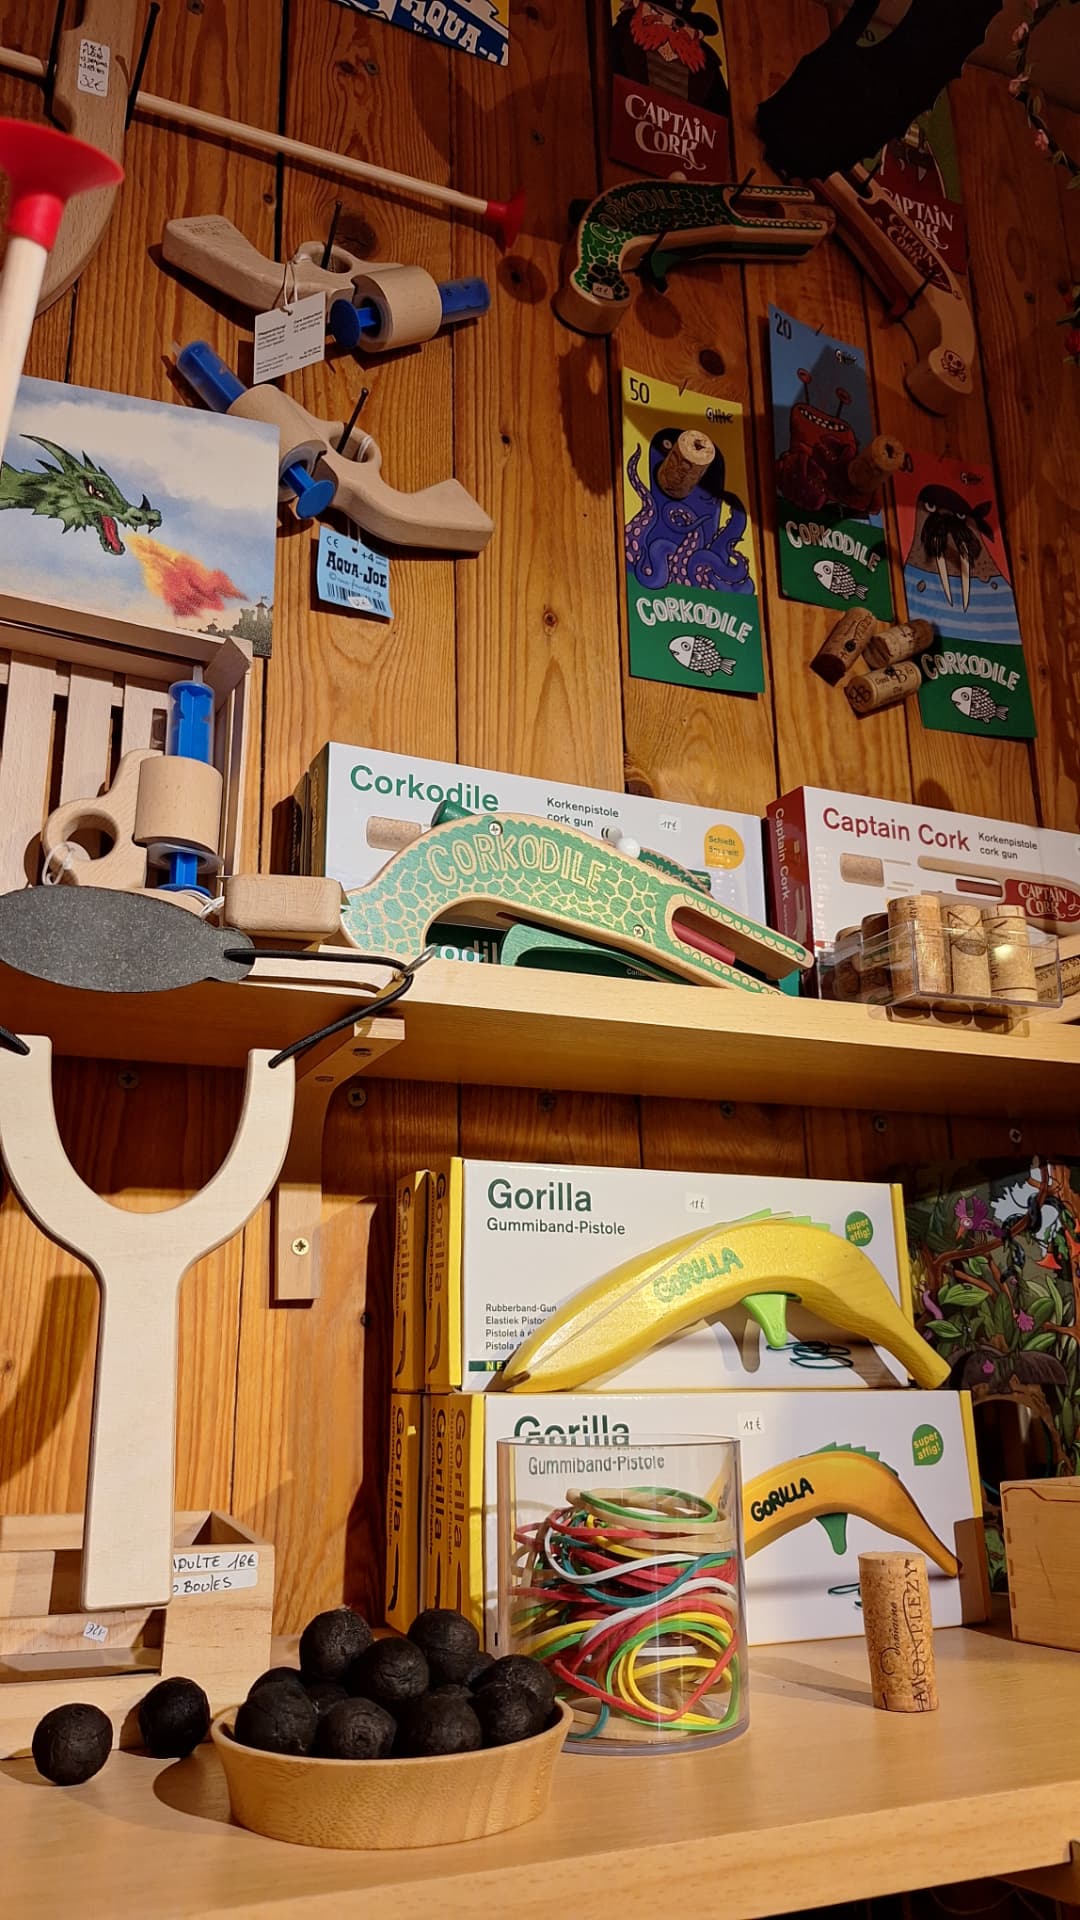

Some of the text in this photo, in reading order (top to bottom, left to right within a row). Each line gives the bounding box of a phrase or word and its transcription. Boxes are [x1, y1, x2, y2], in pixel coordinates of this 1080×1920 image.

[634, 120, 707, 170] CORK
[774, 312, 793, 341] 20
[629, 377, 650, 404] 50
[785, 520, 881, 573] CORKODILE
[326, 550, 388, 589] AQUA-JOE
[636, 597, 753, 645] CORKODILE
[920, 651, 1021, 691] CORKODILE
[350, 764, 500, 812] Corkodile
[546, 797, 620, 818] Korkenpistole
[546, 813, 594, 828] cork gun
[775, 807, 786, 863] Captain
[822, 807, 971, 852] Captain Cork
[977, 831, 1038, 850] Korkenpistole
[425, 833, 607, 894] CORKODILE
[979, 846, 1019, 860] cork gun
[780, 865, 791, 901] Cork
[1025, 897, 1066, 920] CORK
[487, 1178, 592, 1212] Gorilla
[434, 1173, 446, 1292] Gorilla
[486, 1216, 626, 1235] Gummiband-Pistole
[846, 1218, 868, 1232] super
[401, 1187, 411, 1301] Gorilla
[485, 1303, 557, 1313] Rubberband-Gun
[485, 1316, 520, 1326] Elastiek
[485, 1329, 518, 1338] Pistolet
[485, 1341, 515, 1351] Pistola
[513, 1414, 630, 1447] Gorilla
[913, 1431, 938, 1449] super
[528, 1455, 665, 1476] Gummiband-Pistole
[917, 1441, 941, 1460] affig!
[393, 1407, 404, 1531] Gorilla
[434, 1409, 446, 1540] Gorilla
[455, 1409, 466, 1548] Gorilla
[184, 1573, 233, 1594] BOULES
